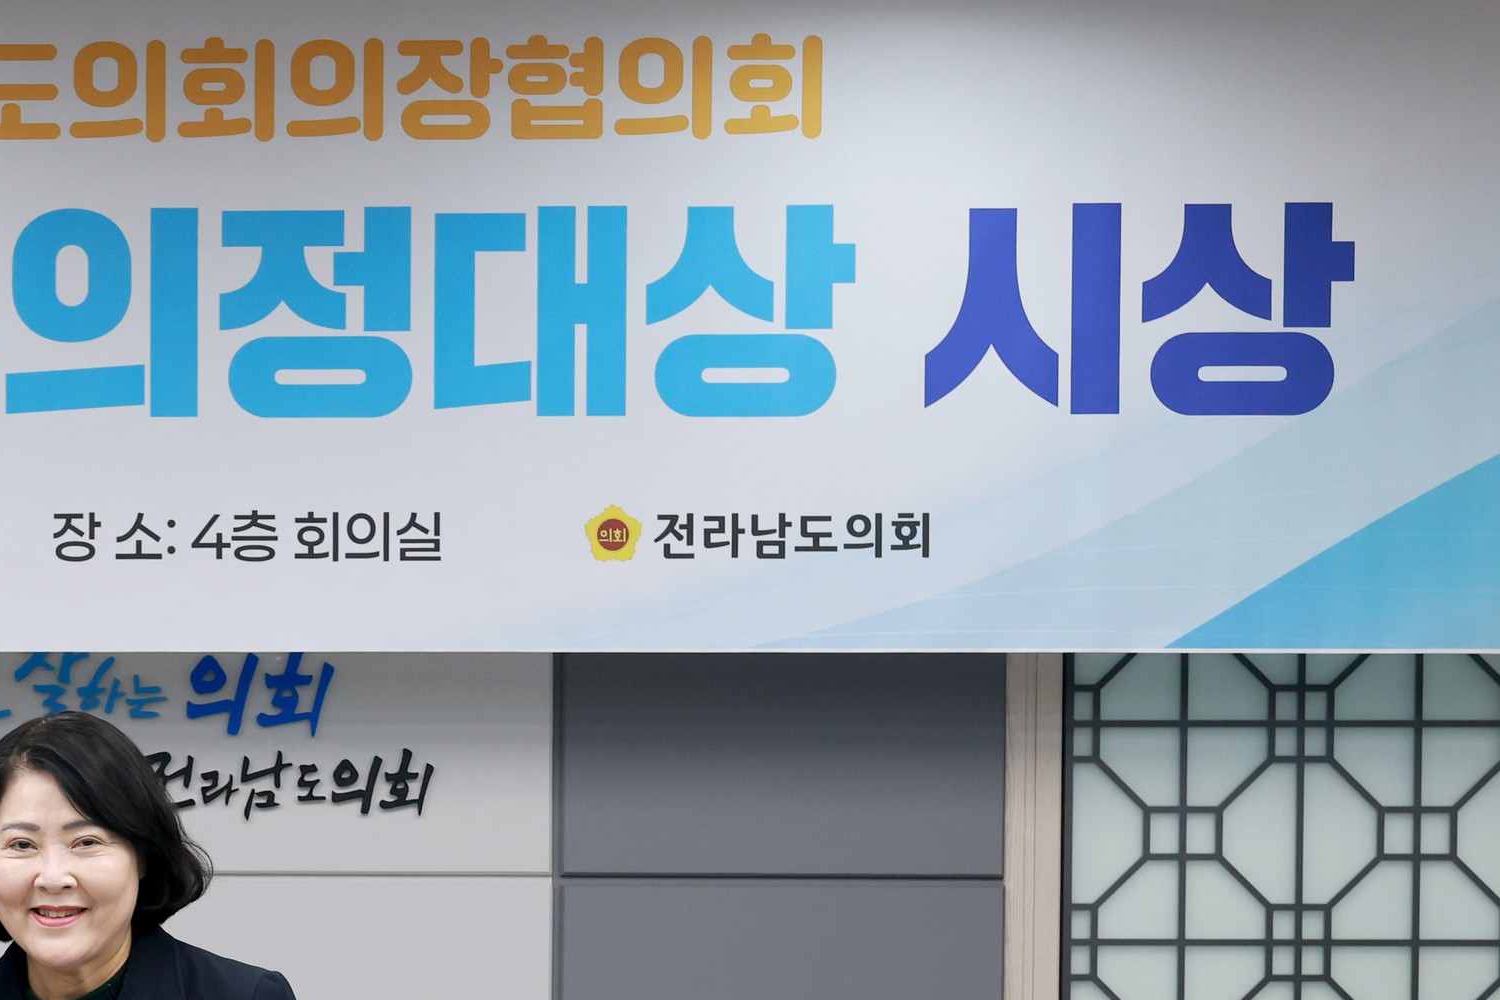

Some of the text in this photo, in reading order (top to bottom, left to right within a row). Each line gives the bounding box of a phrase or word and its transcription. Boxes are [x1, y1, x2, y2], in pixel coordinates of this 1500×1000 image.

[924, 202, 1356, 416] 시상
[190, 508, 280, 563] 4층
[293, 510, 443, 563] 회의실
[652, 511, 931, 561] 전라남도의회
[186, 651, 335, 738] 의회
[145, 747, 435, 821] 전라남도의회
